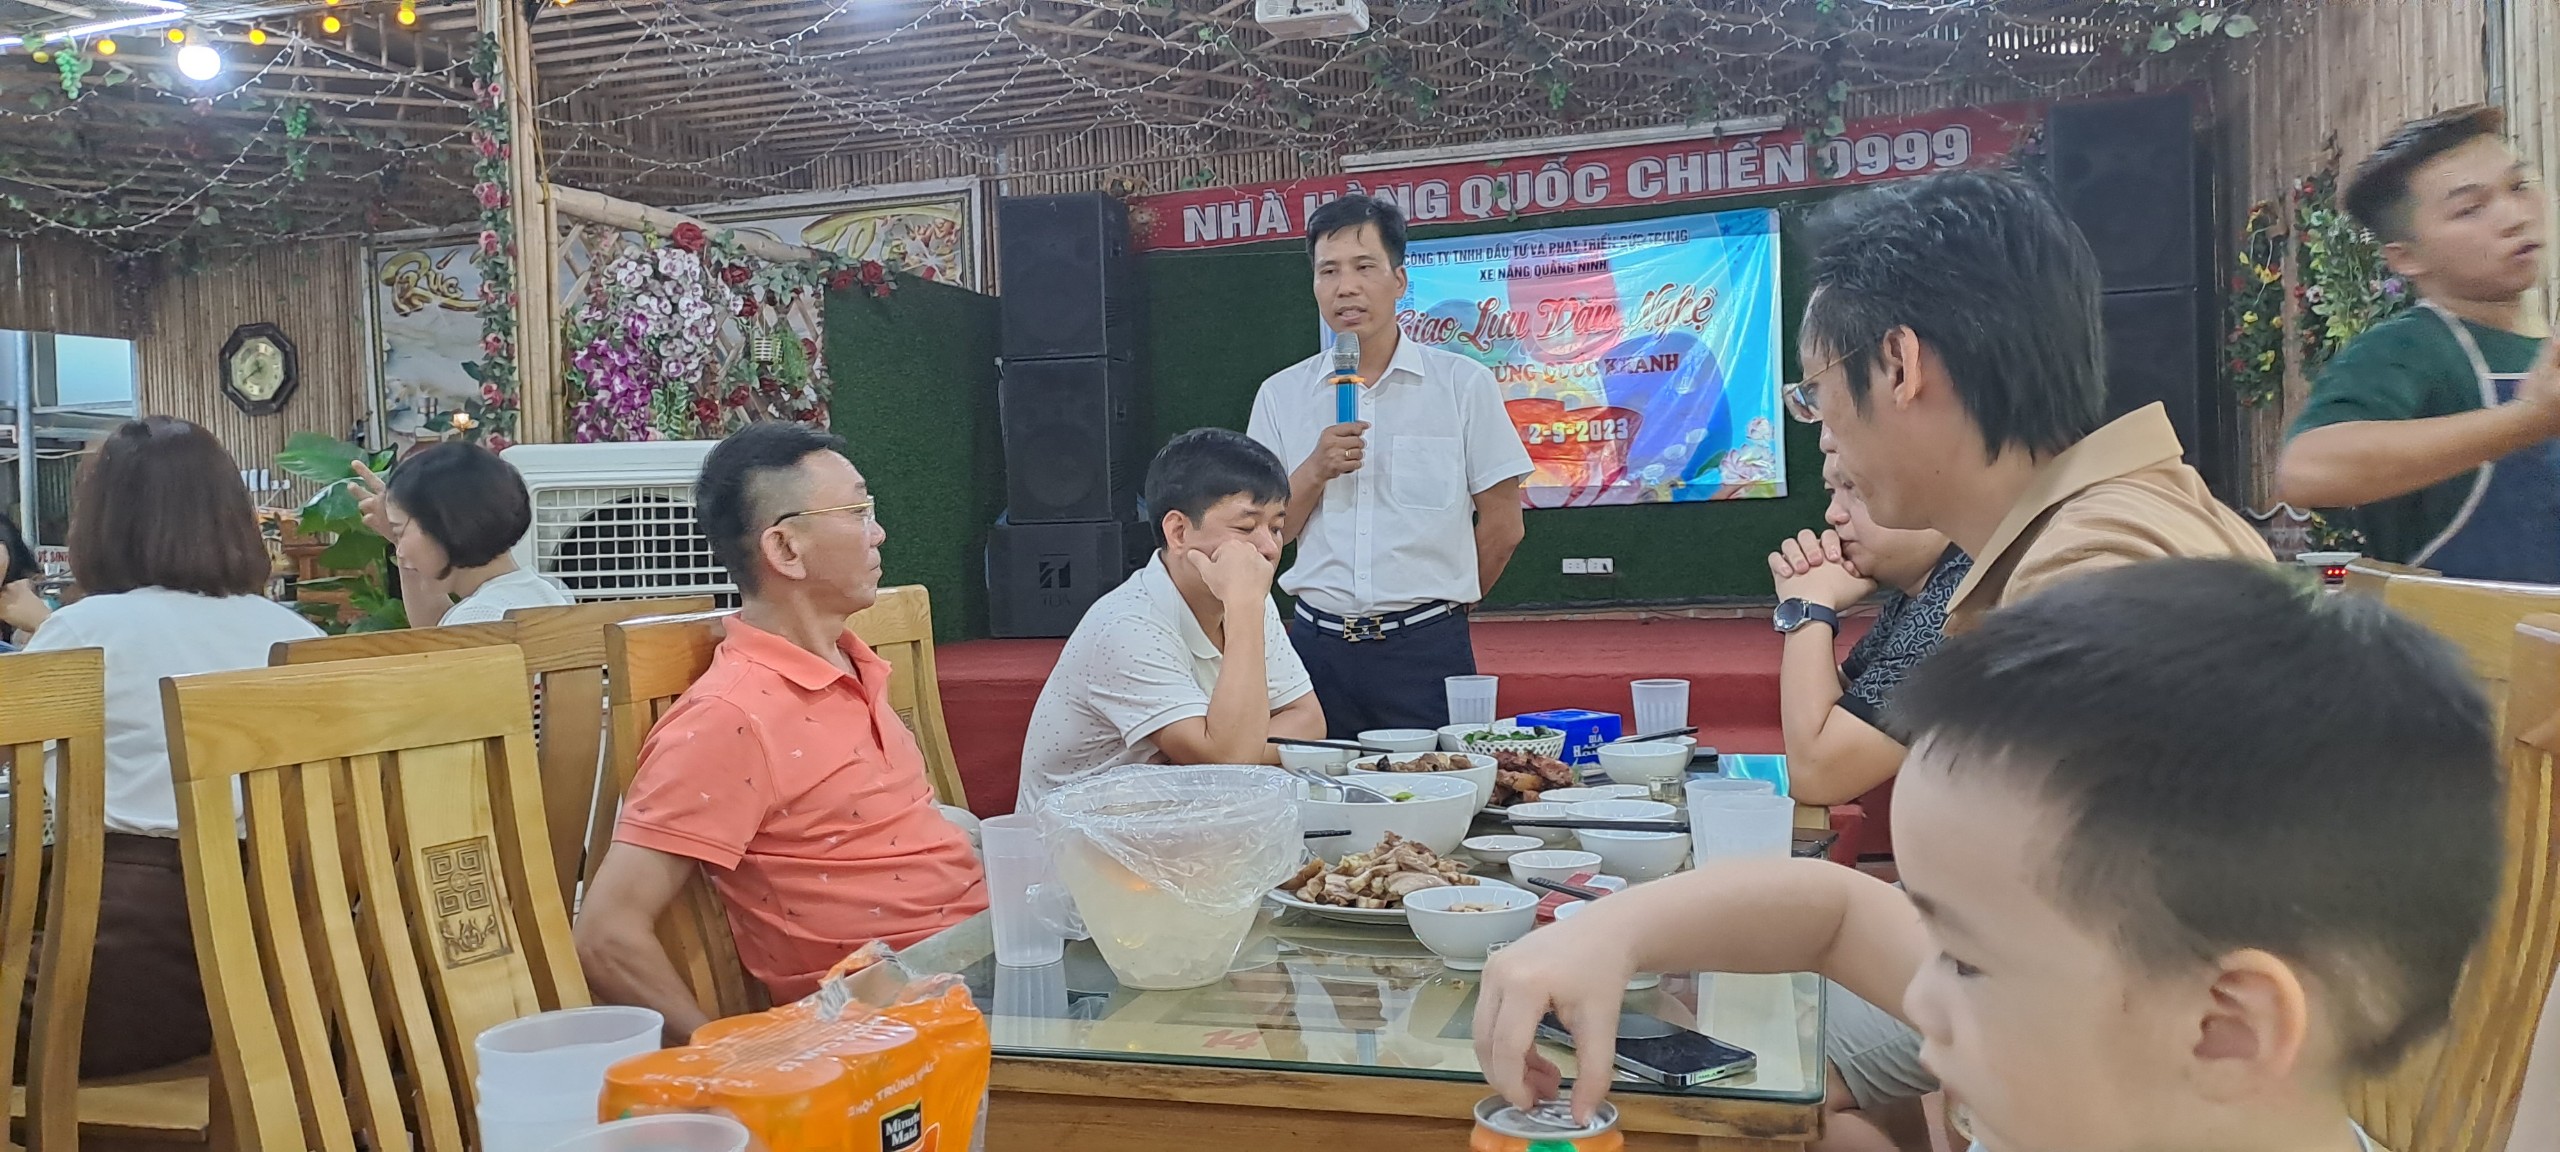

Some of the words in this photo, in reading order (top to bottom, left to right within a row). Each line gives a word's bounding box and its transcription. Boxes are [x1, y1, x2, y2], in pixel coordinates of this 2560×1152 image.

[1183, 191, 1292, 243] NHÀ
[1303, 180, 1450, 231] NG
[1459, 155, 1609, 219] QUỐC
[1627, 136, 1809, 198] CHIẾN
[1816, 124, 1971, 180] 9999
[1403, 250, 1434, 266] CÔNG
[1437, 251, 1450, 264] TY
[1453, 248, 1483, 263] TNHH
[1479, 269, 1494, 281] XE
[1497, 264, 1531, 279] NÂNG
[1534, 259, 1574, 278] QUẢNG
[1577, 259, 1607, 273] NINH
[1458, 297, 1529, 352] Lưu
[1490, 360, 1536, 383] ỪNG
[1202, 1028, 1263, 1051] 14
[891, 1123, 919, 1147] Maid
